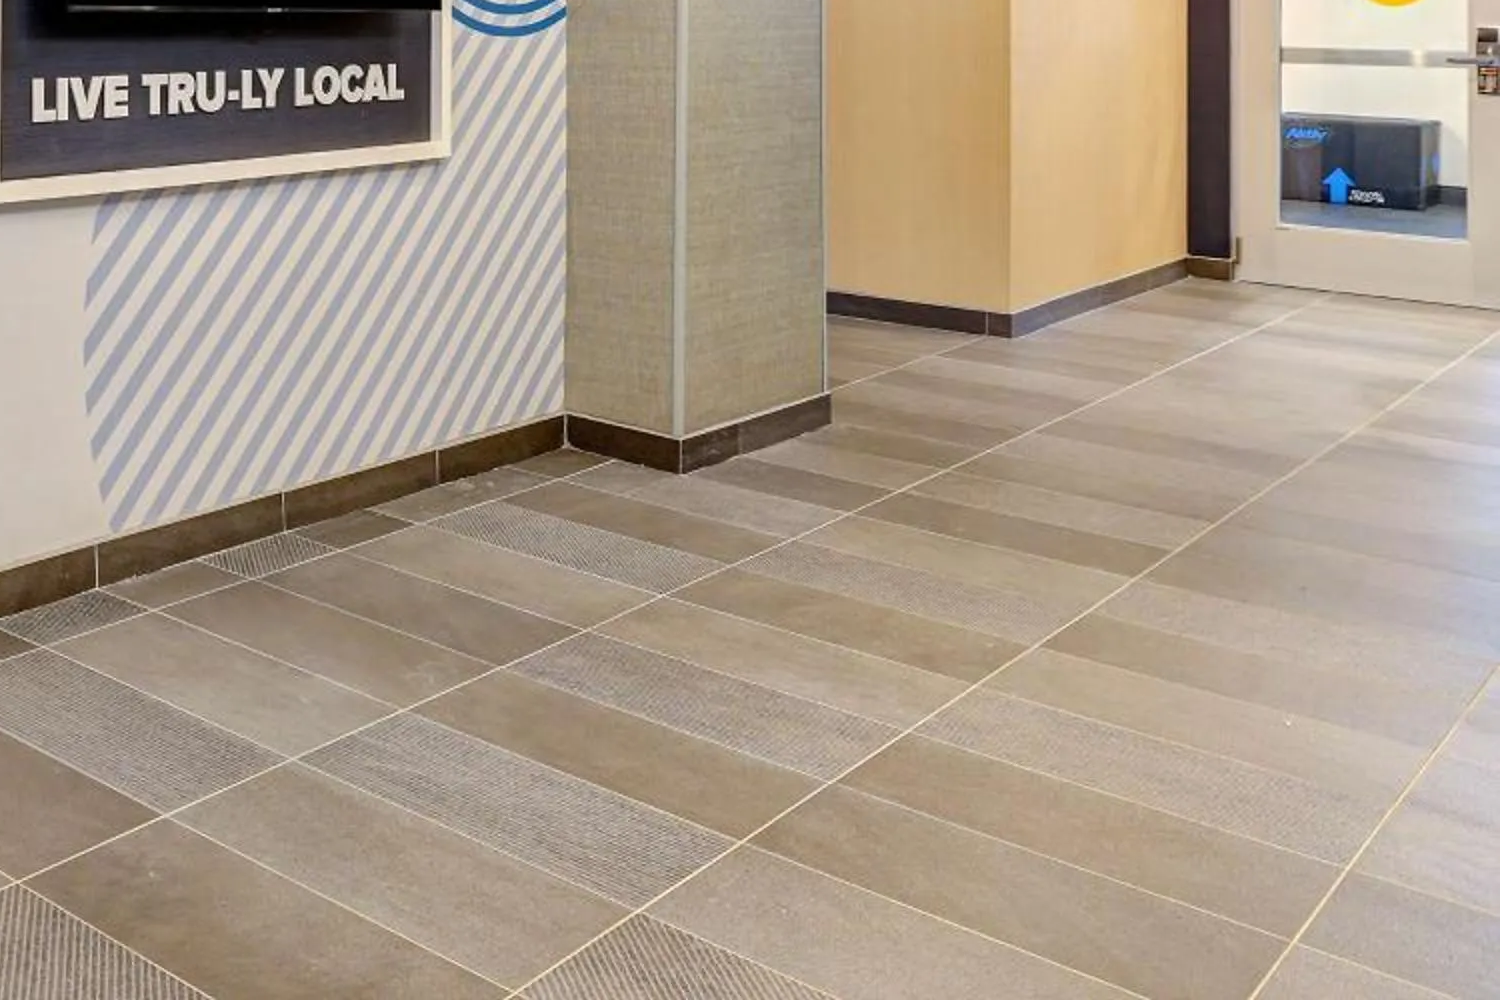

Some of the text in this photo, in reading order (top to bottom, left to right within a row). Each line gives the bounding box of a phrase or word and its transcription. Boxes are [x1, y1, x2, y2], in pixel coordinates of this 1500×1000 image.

[30, 63, 406, 124] LIVE TRU-LY LOCAL
